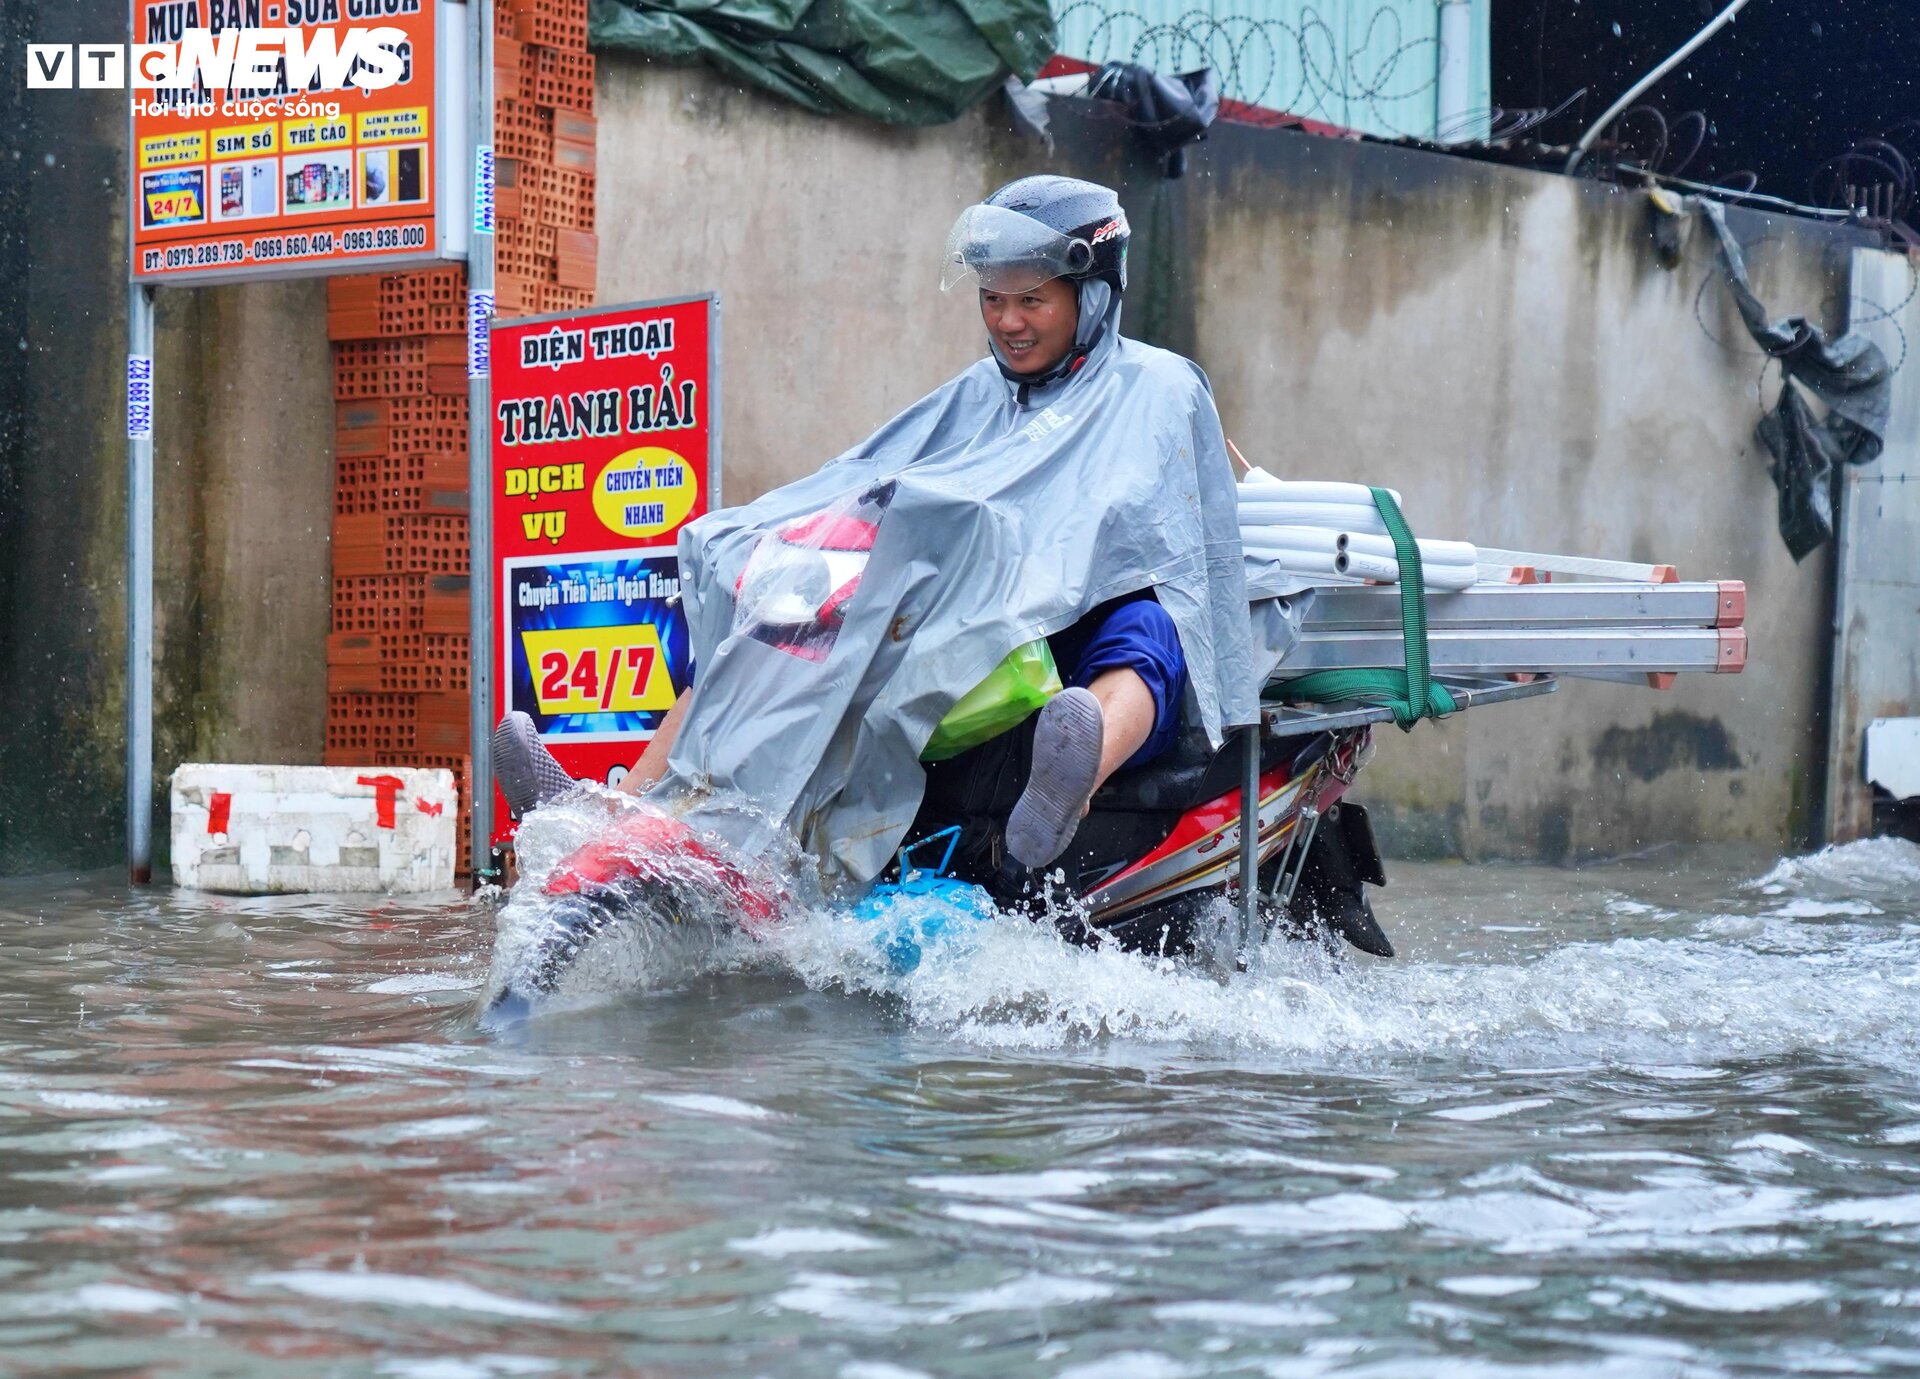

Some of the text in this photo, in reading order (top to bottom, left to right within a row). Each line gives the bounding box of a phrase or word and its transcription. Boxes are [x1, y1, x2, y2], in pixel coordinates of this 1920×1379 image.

[147, 1, 199, 44] MUA
[216, 136, 245, 153] SIM
[153, 196, 193, 217] 24/7
[166, 242, 243, 267] 0979.289.738
[254, 233, 333, 260] 0969.660.404
[343, 226, 425, 250] 0963.936.000
[523, 322, 673, 368] ĐIỆN THOẠI
[128, 359, 150, 432] 0932 899 822
[499, 364, 696, 444] THANH HẢI
[504, 462, 585, 502] DỊCH
[605, 460, 651, 492] CHUYỂN
[521, 510, 567, 545] VỤ
[625, 503, 664, 526] NHANH
[518, 575, 560, 612] Chuyển
[589, 575, 615, 603] Liên
[617, 574, 647, 607] Ngân
[541, 647, 656, 710] 24/7
